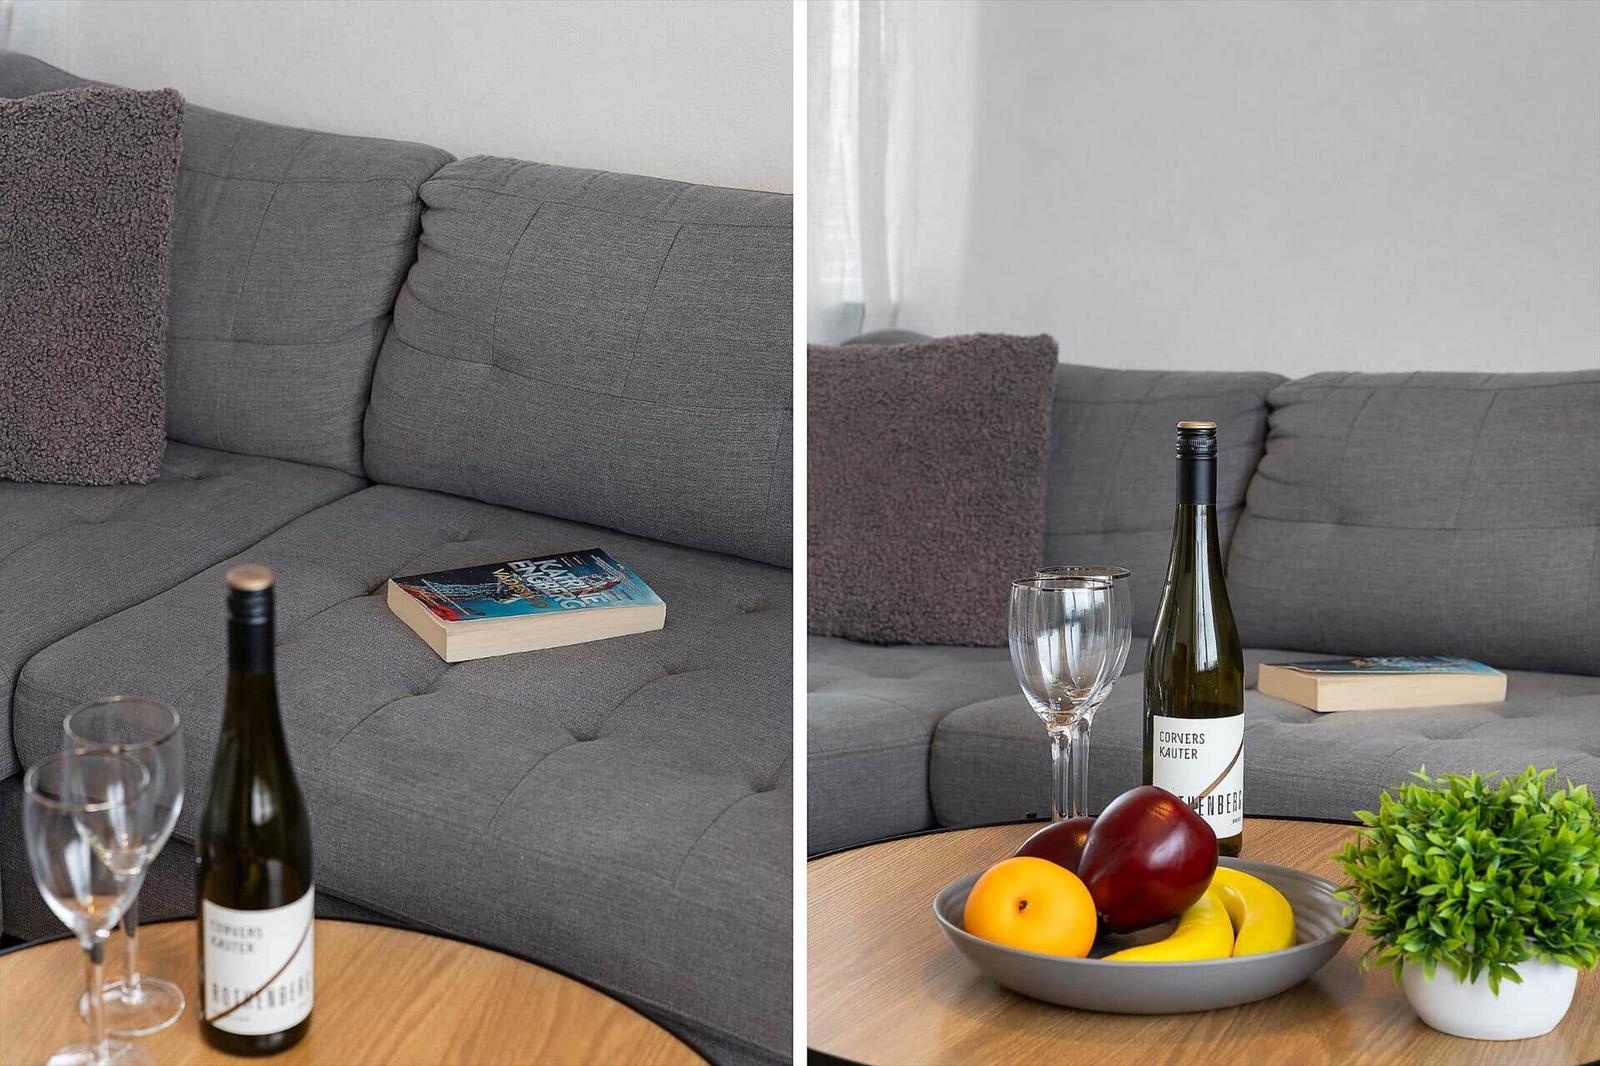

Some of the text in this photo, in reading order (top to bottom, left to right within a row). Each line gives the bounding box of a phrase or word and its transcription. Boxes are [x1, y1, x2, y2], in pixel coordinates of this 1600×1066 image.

[508, 561, 587, 608] ENGBERG
[534, 559, 608, 603] KATRINE
[1160, 730, 1205, 745] CORVERS
[1160, 746, 1199, 760] KAUTER
